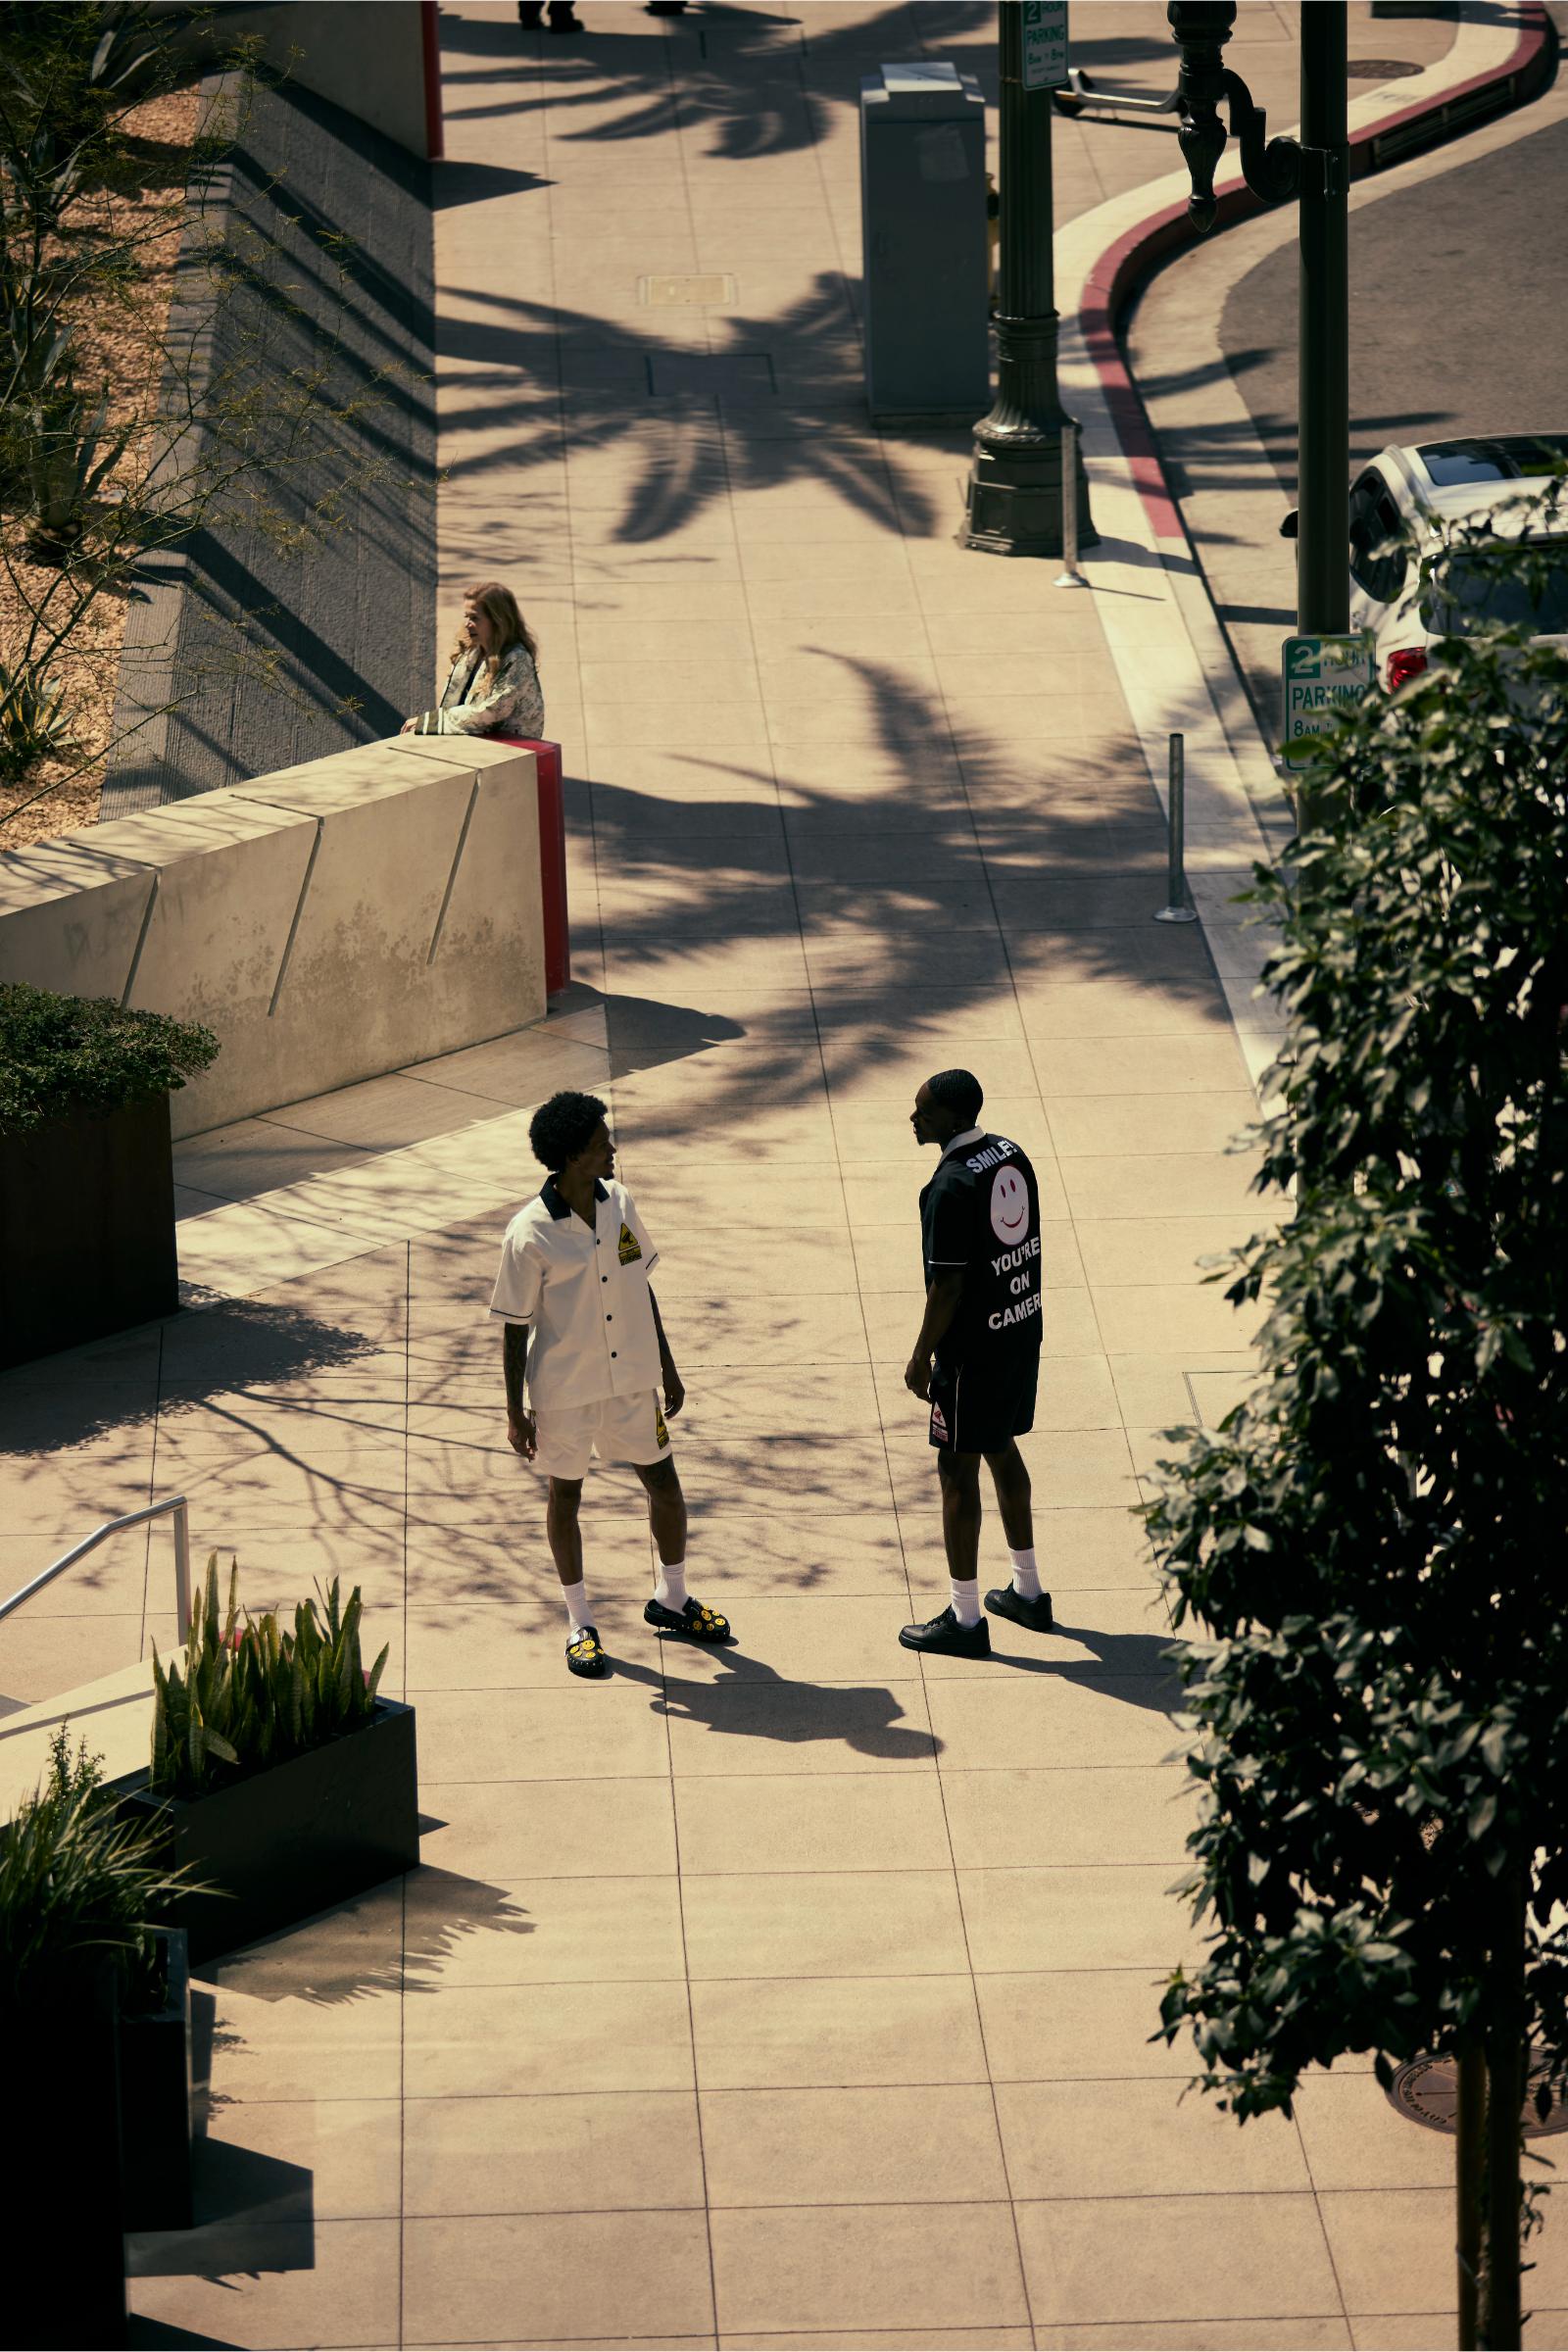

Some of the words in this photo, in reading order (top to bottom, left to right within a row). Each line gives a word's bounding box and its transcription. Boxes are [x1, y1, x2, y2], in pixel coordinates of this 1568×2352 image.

[1027, 1, 1039, 21] 2
[1027, 24, 1064, 46] PARKING
[1294, 646, 1314, 674] 2
[1294, 719, 1320, 737] 8AM
[966, 1140, 1017, 1173] SMILE!
[991, 1237, 1041, 1277] YOU'RE
[1009, 1270, 1030, 1295] ON
[988, 1292, 1042, 1330] CAMER
